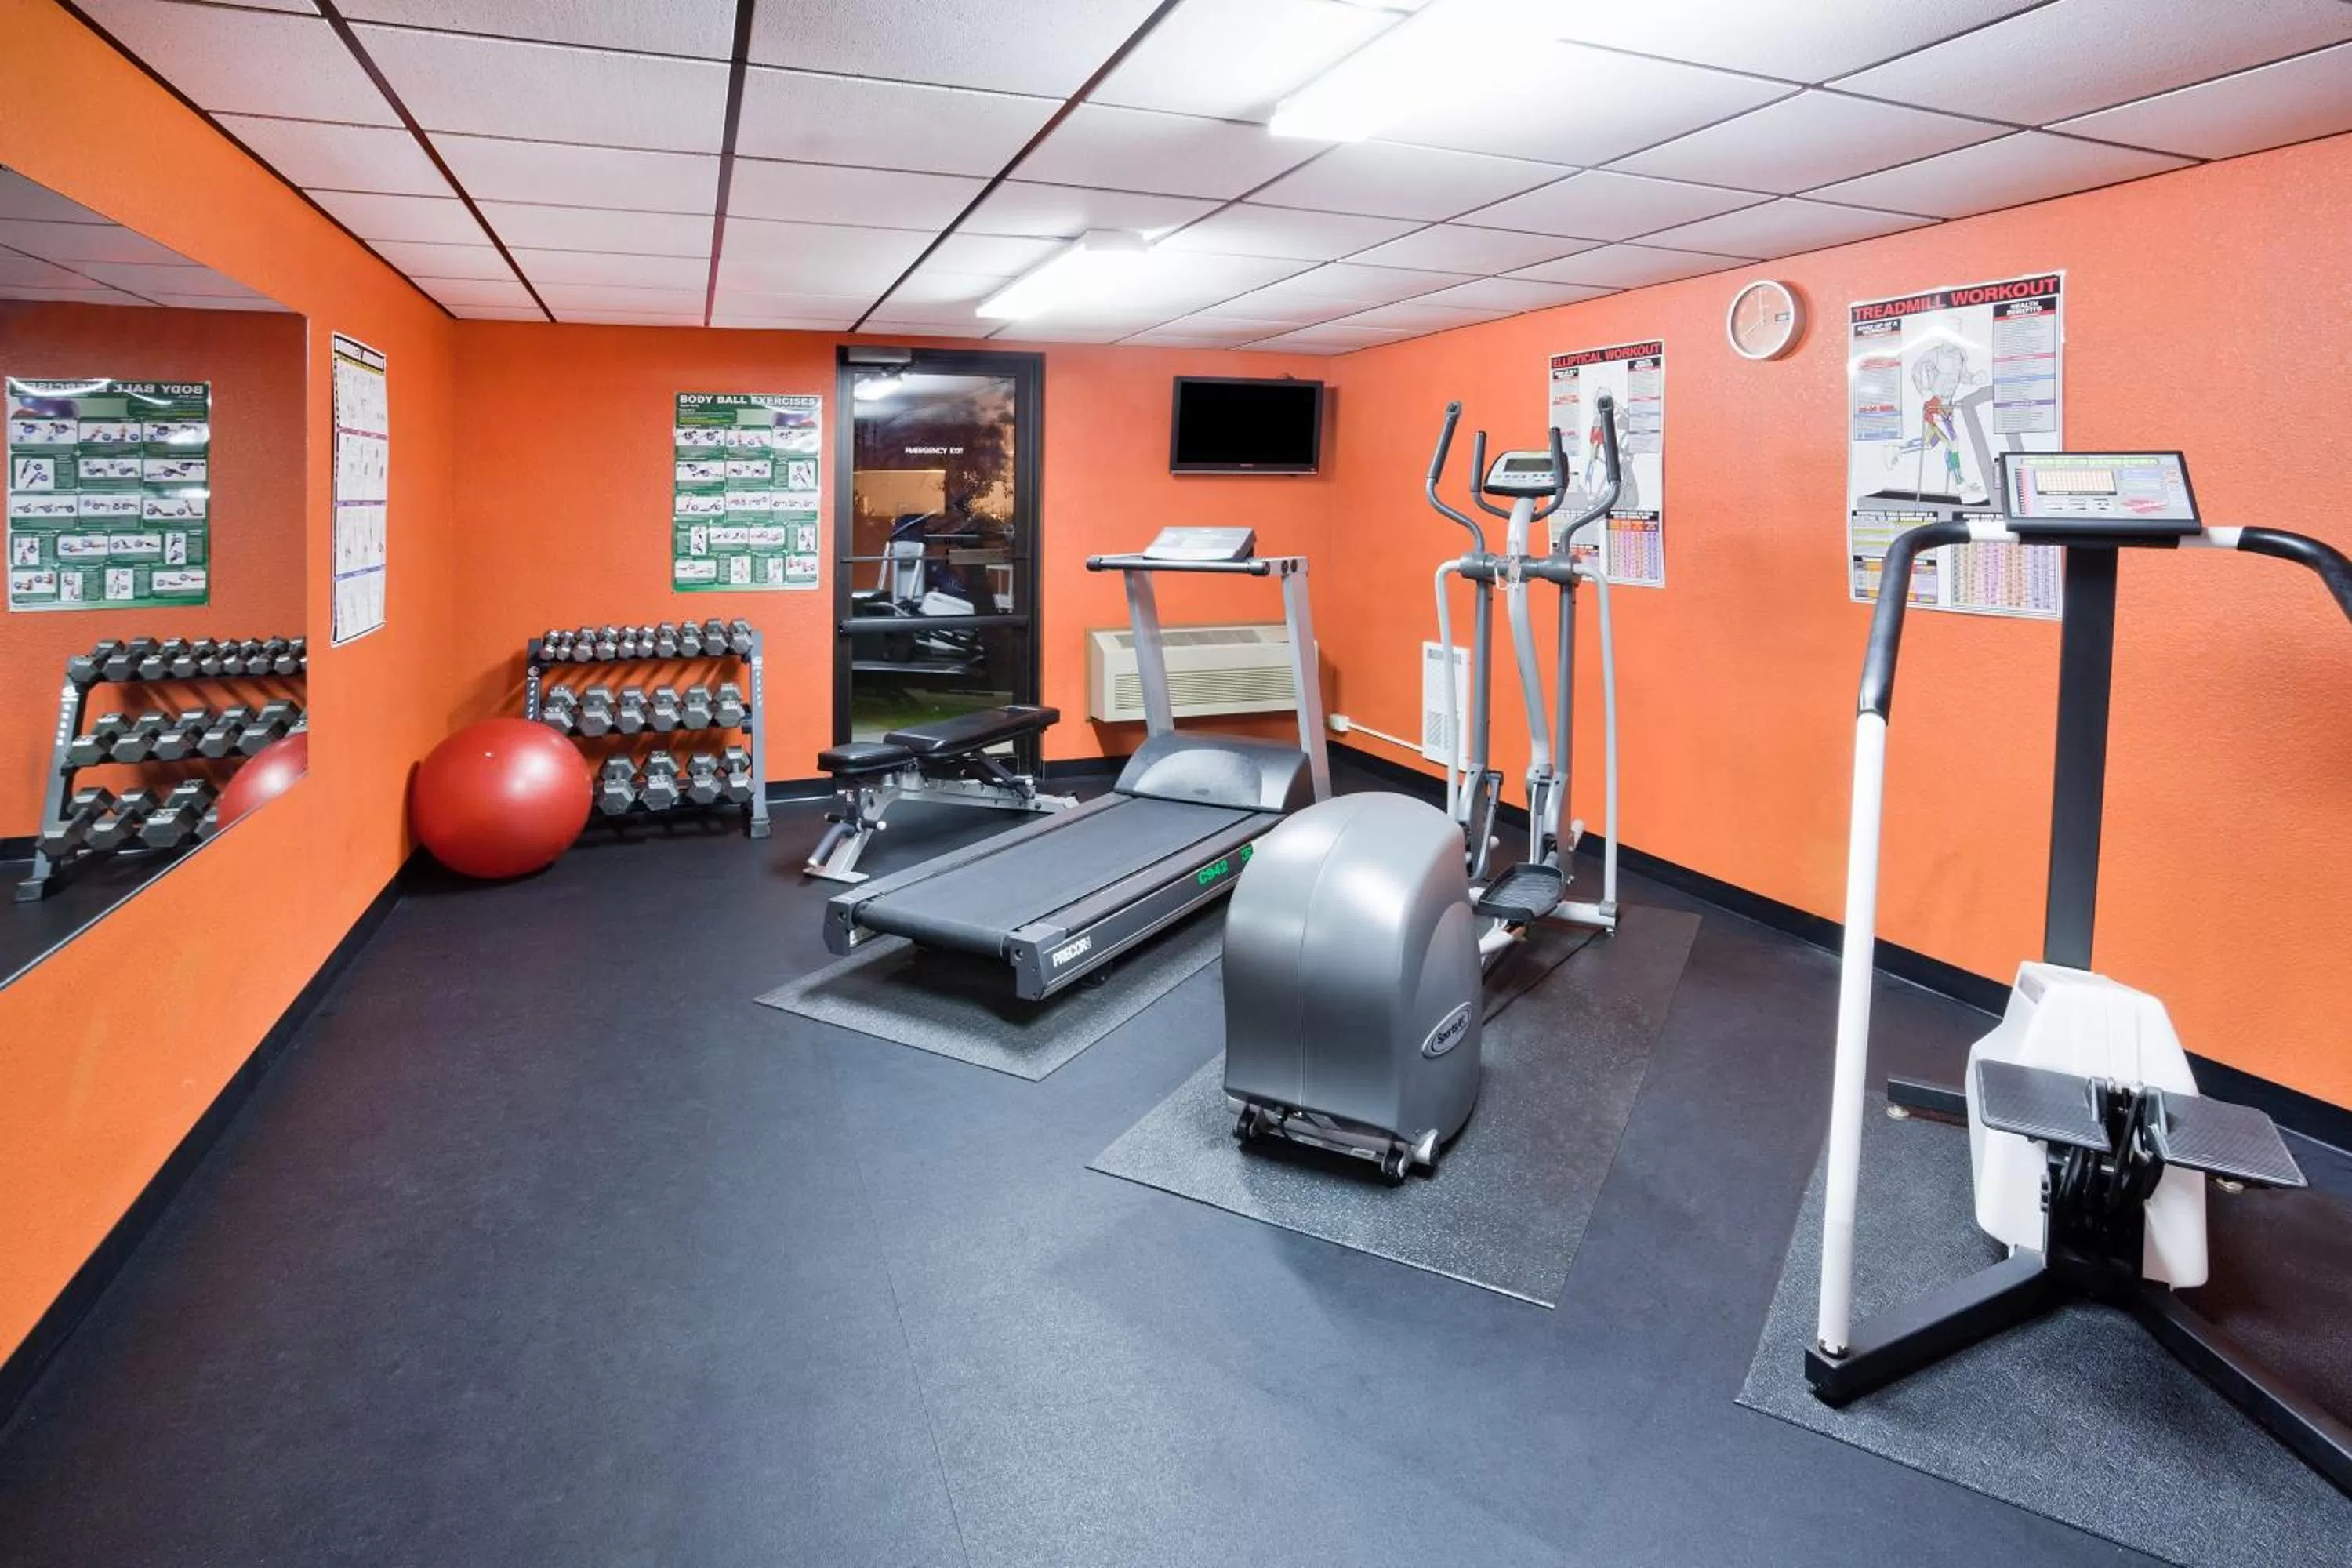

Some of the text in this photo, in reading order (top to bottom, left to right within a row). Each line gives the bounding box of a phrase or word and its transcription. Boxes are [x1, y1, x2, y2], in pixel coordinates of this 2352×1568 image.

[1854, 278, 2058, 321] TREADMILL WORKOUT
[1552, 343, 1660, 368] ELLIPTICAL WORKOUT
[680, 394, 815, 405] BODY BALL EXERCISES
[1052, 935, 1092, 967] PRECOR
